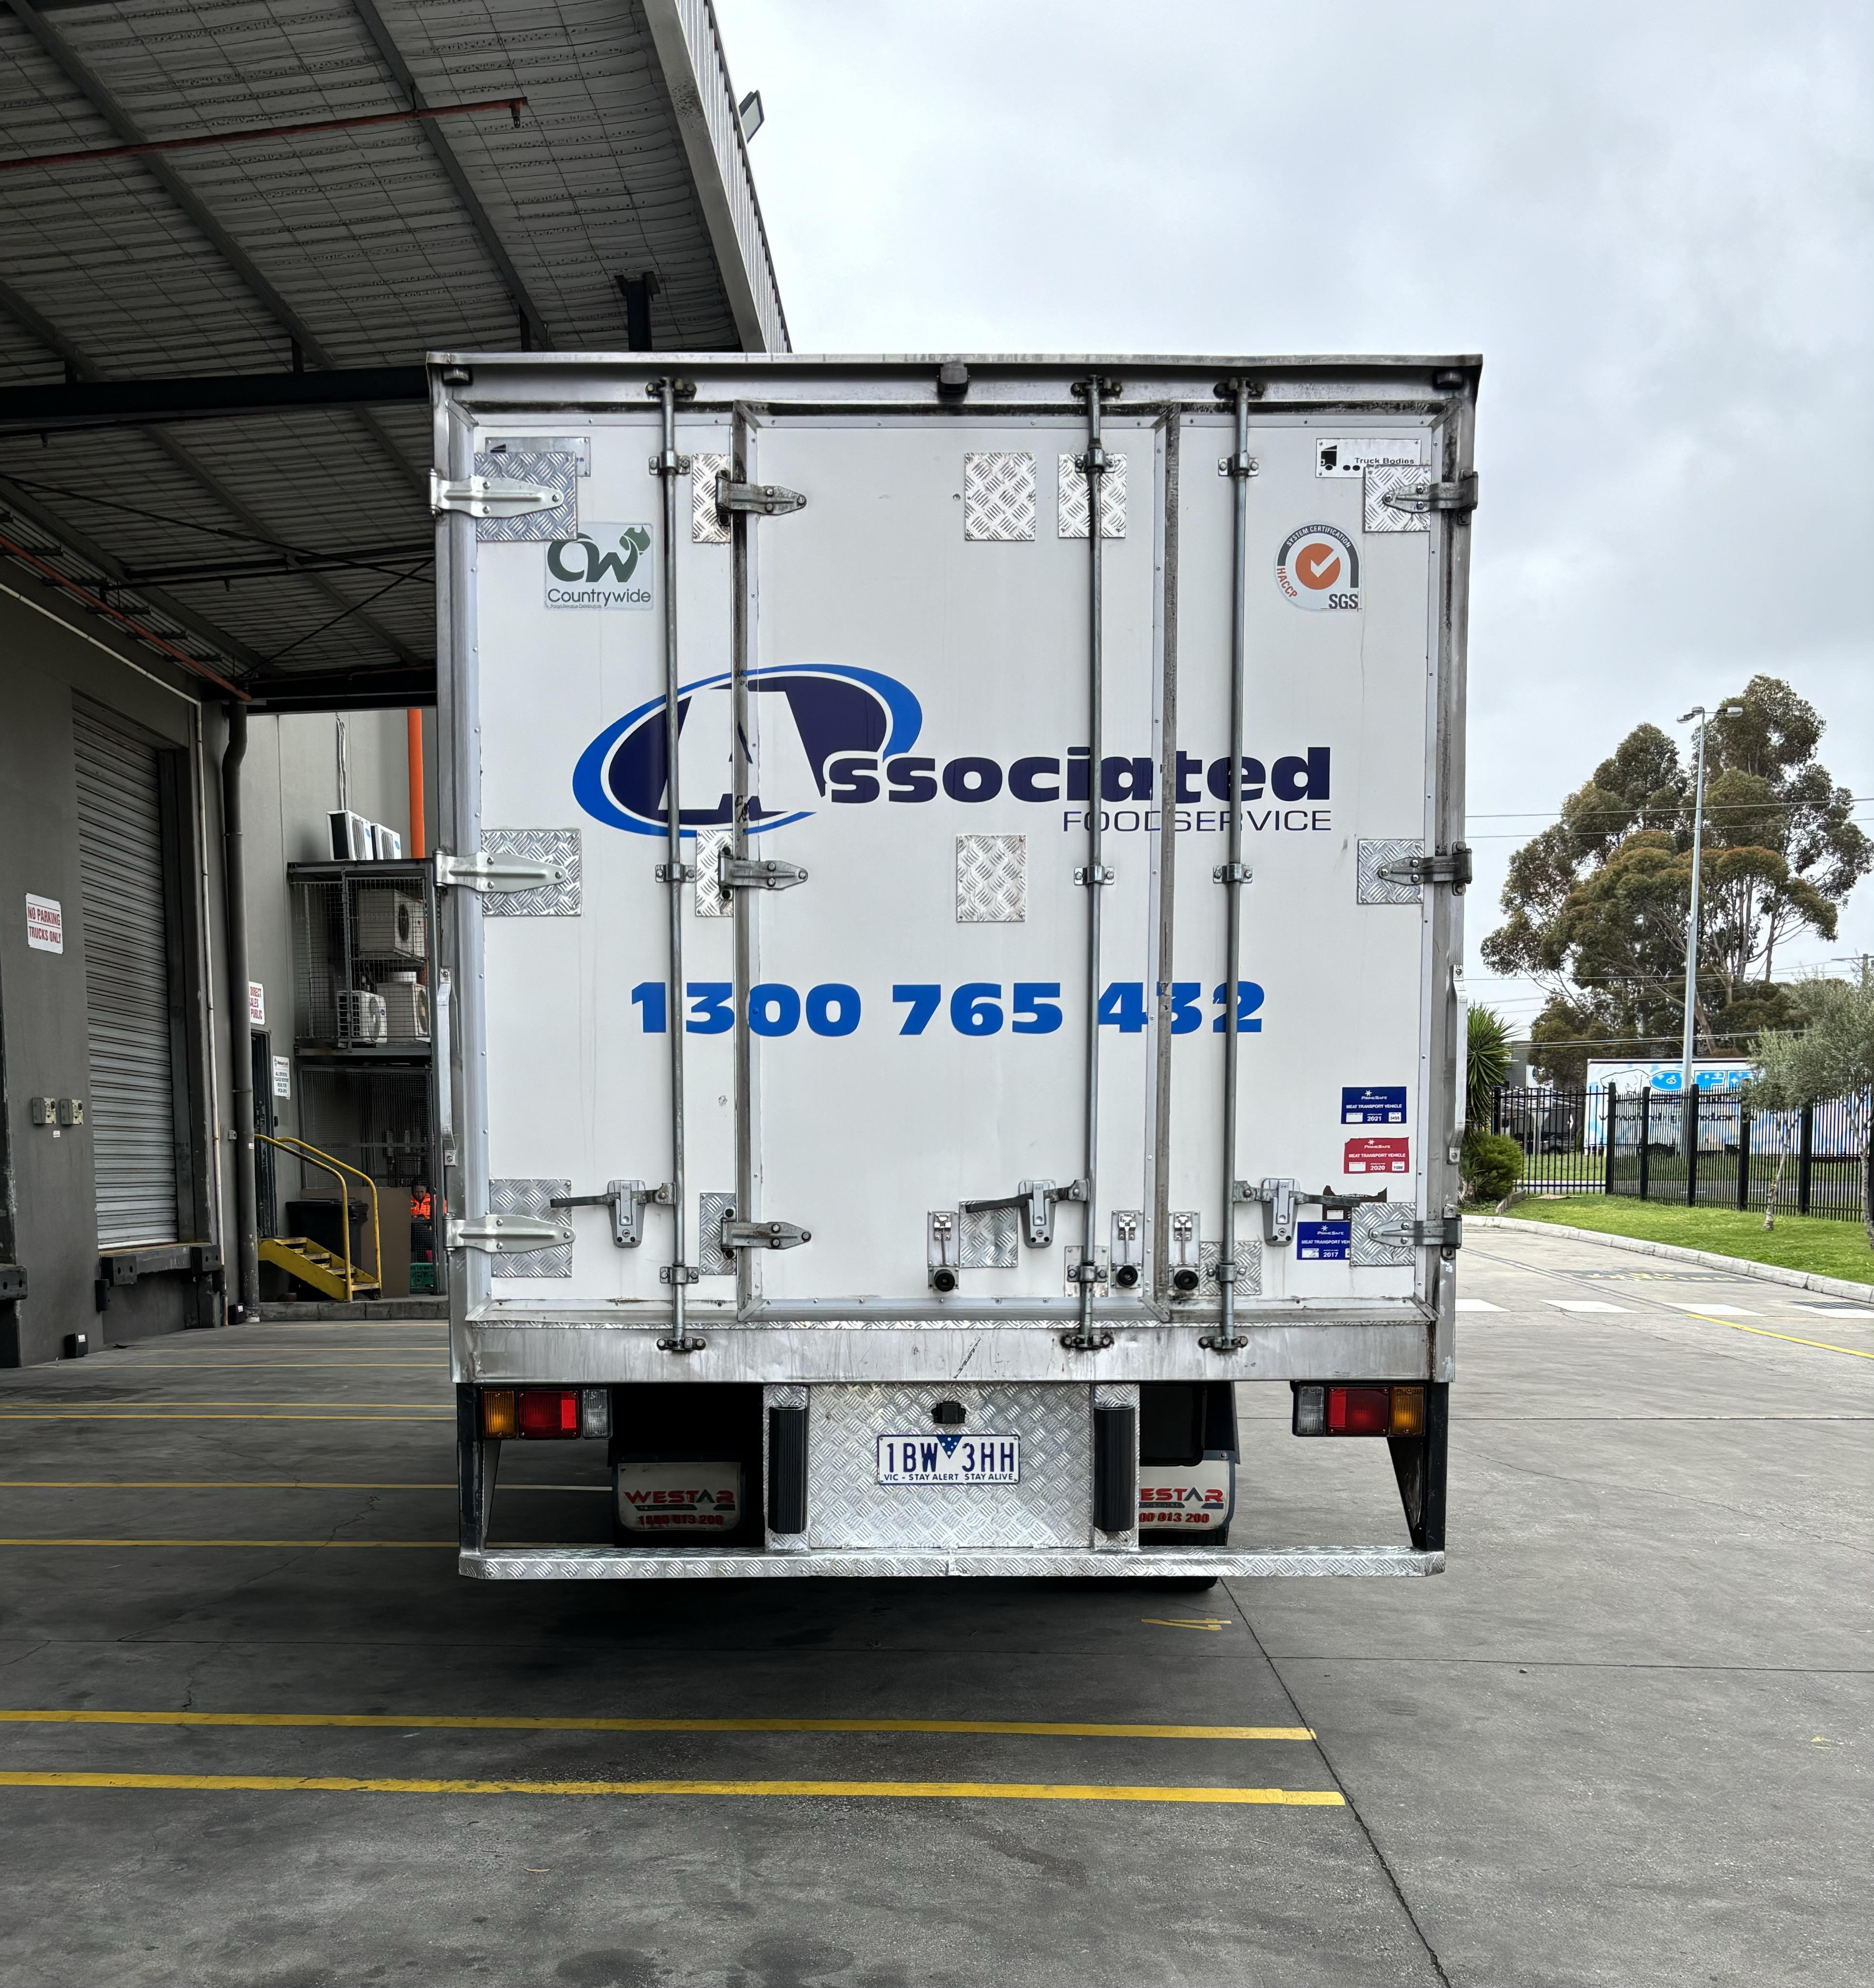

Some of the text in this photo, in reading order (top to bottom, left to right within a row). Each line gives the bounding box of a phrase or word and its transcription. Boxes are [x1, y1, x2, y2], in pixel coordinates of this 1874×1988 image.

[1286, 526, 1351, 548] SYSTEM CERTIFICATION
[1276, 568, 1298, 597] HACCP
[547, 588, 651, 607] Countrywide
[1328, 593, 1358, 609] SGS
[28, 906, 60, 926] NO PARKING
[28, 926, 61, 944] TRUCKS ONLY
[631, 981, 1265, 1037] 1300 765 432
[886, 1442, 1014, 1473] 1BW 3HH
[624, 1488, 735, 1504] WESTAR
[1139, 1487, 1224, 1502] ESTAR
[1157, 1512, 1182, 1522] 013
[1185, 1513, 1210, 1523] 200
